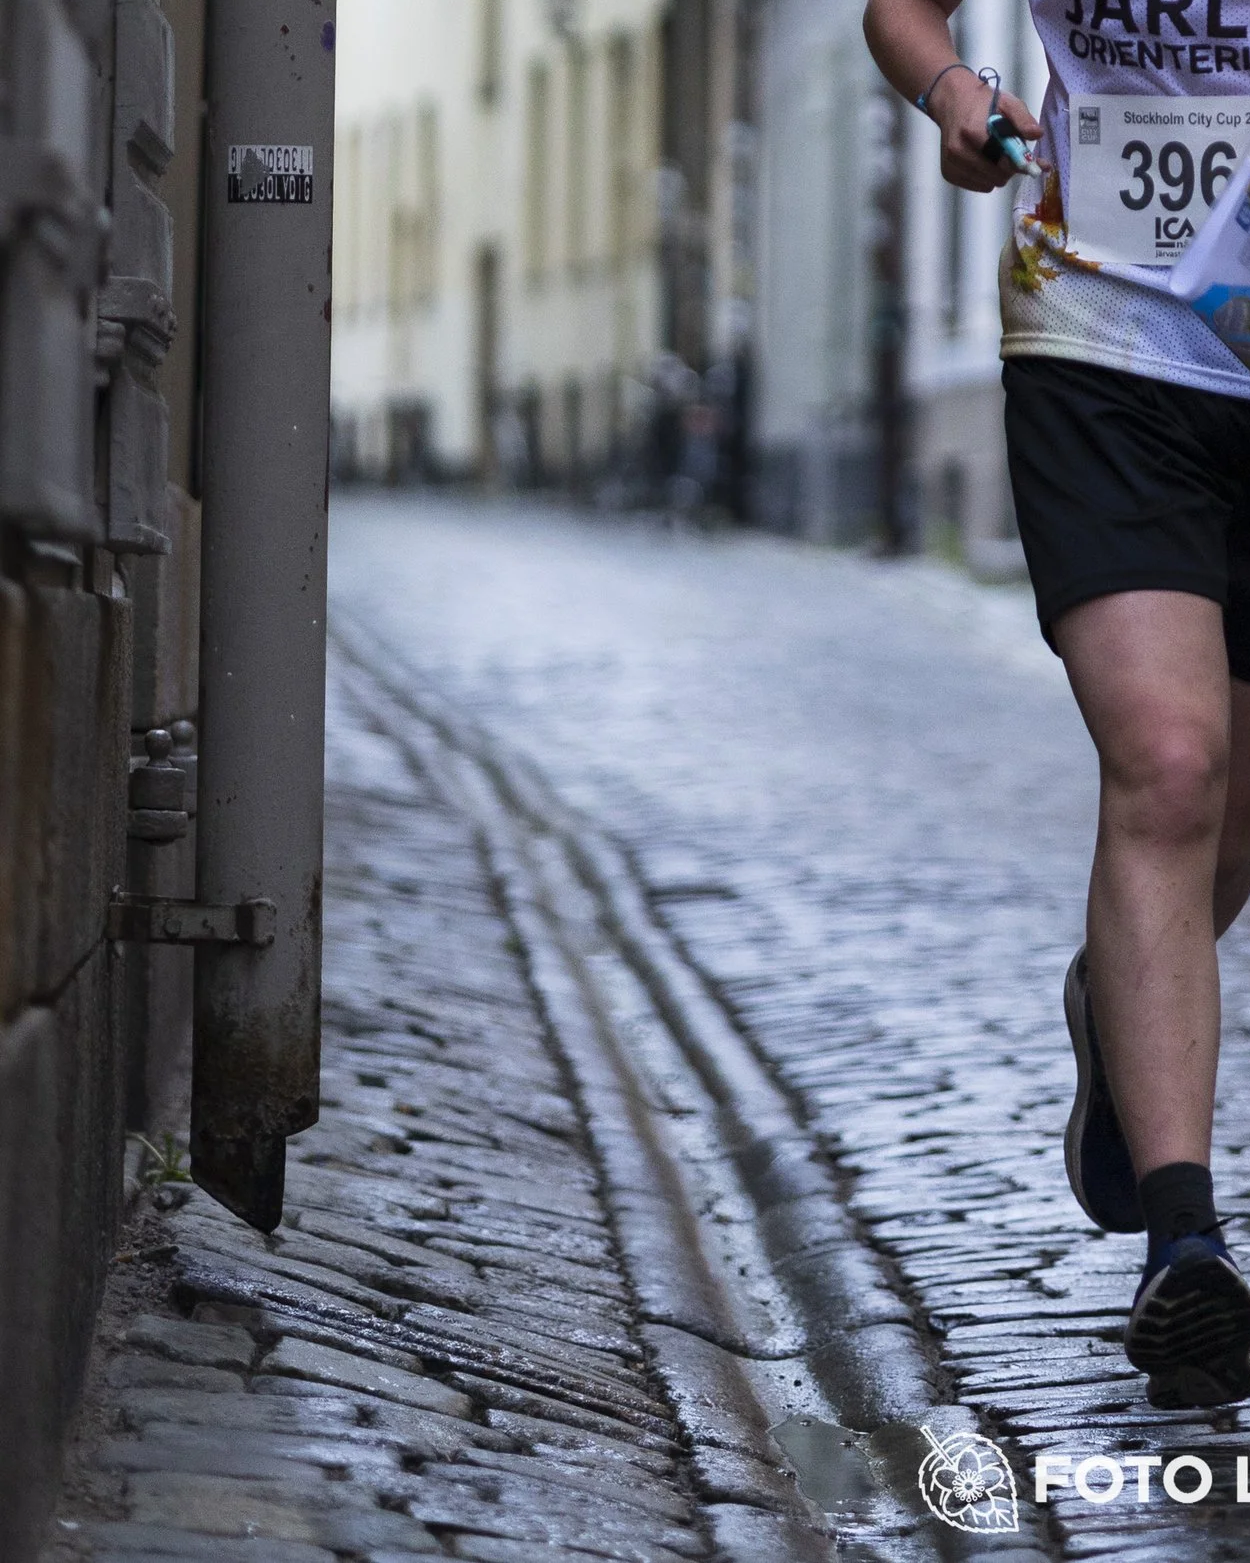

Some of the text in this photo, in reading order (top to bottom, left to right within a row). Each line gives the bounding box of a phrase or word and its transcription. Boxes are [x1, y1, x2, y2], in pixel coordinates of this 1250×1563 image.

[1124, 111, 1184, 126] Stockholm
[1188, 112, 1212, 129] City
[1216, 112, 1241, 129] Cup
[1119, 140, 1238, 212] 396
[1155, 217, 1195, 240] ICA
